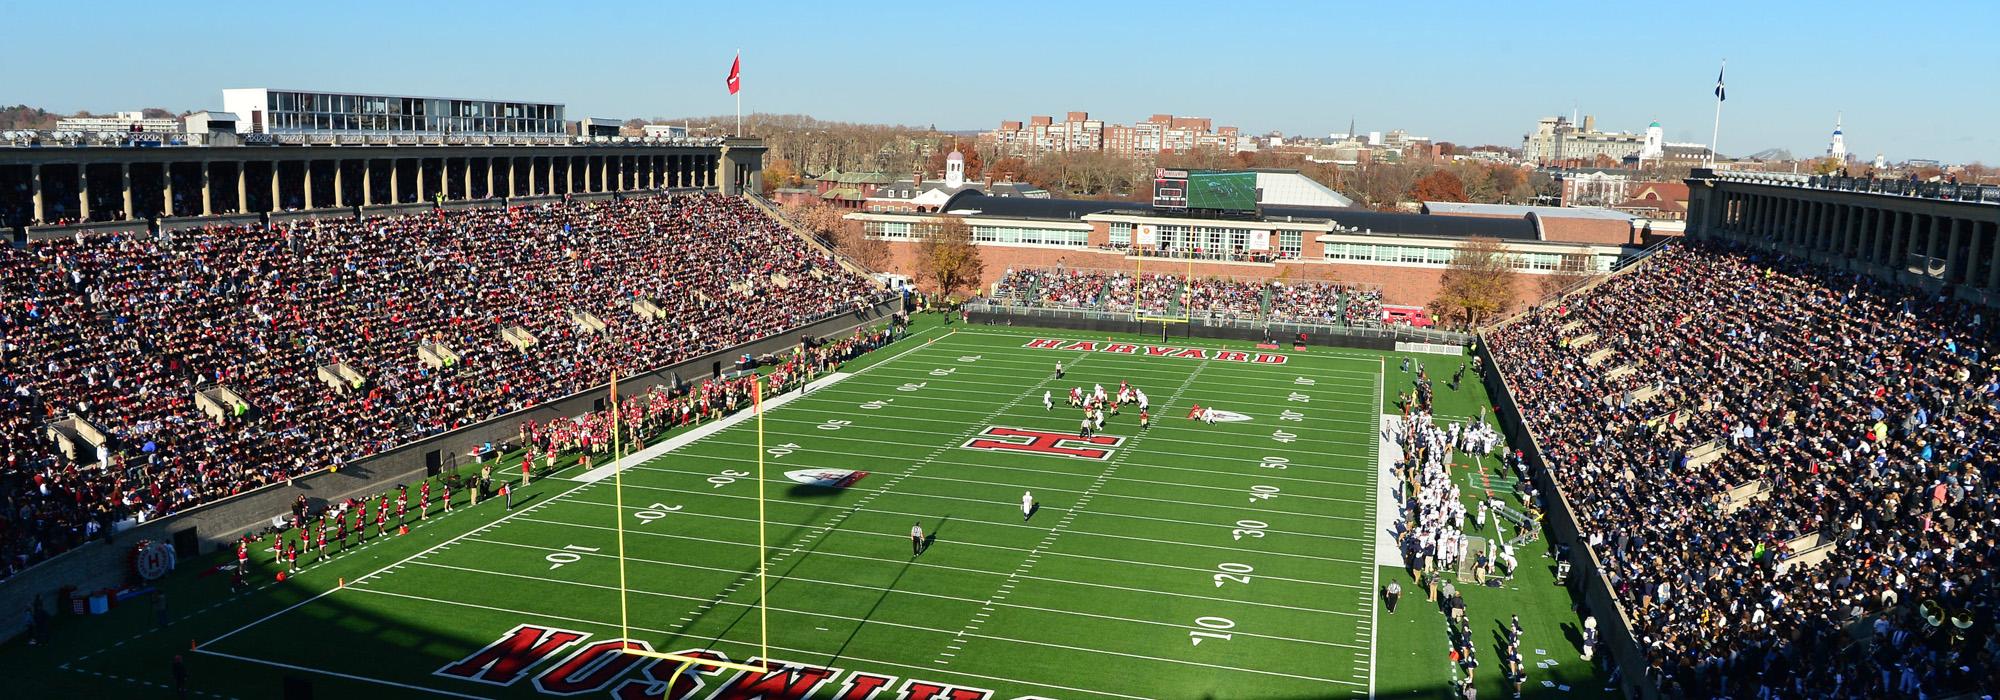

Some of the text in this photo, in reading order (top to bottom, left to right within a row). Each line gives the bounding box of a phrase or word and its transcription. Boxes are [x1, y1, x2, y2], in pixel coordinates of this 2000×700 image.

[1022, 338, 1289, 364] HARVARD
[817, 419, 852, 430] 50
[766, 442, 802, 455] 40
[960, 425, 1126, 461] H
[1260, 456, 1290, 469] 50
[707, 469, 750, 484] 30
[1250, 485, 1280, 500] 40
[634, 502, 684, 519] 20
[1232, 519, 1269, 538] 30
[545, 544, 600, 563] 10
[1213, 562, 1254, 584] 20
[1189, 616, 1236, 641] 10
